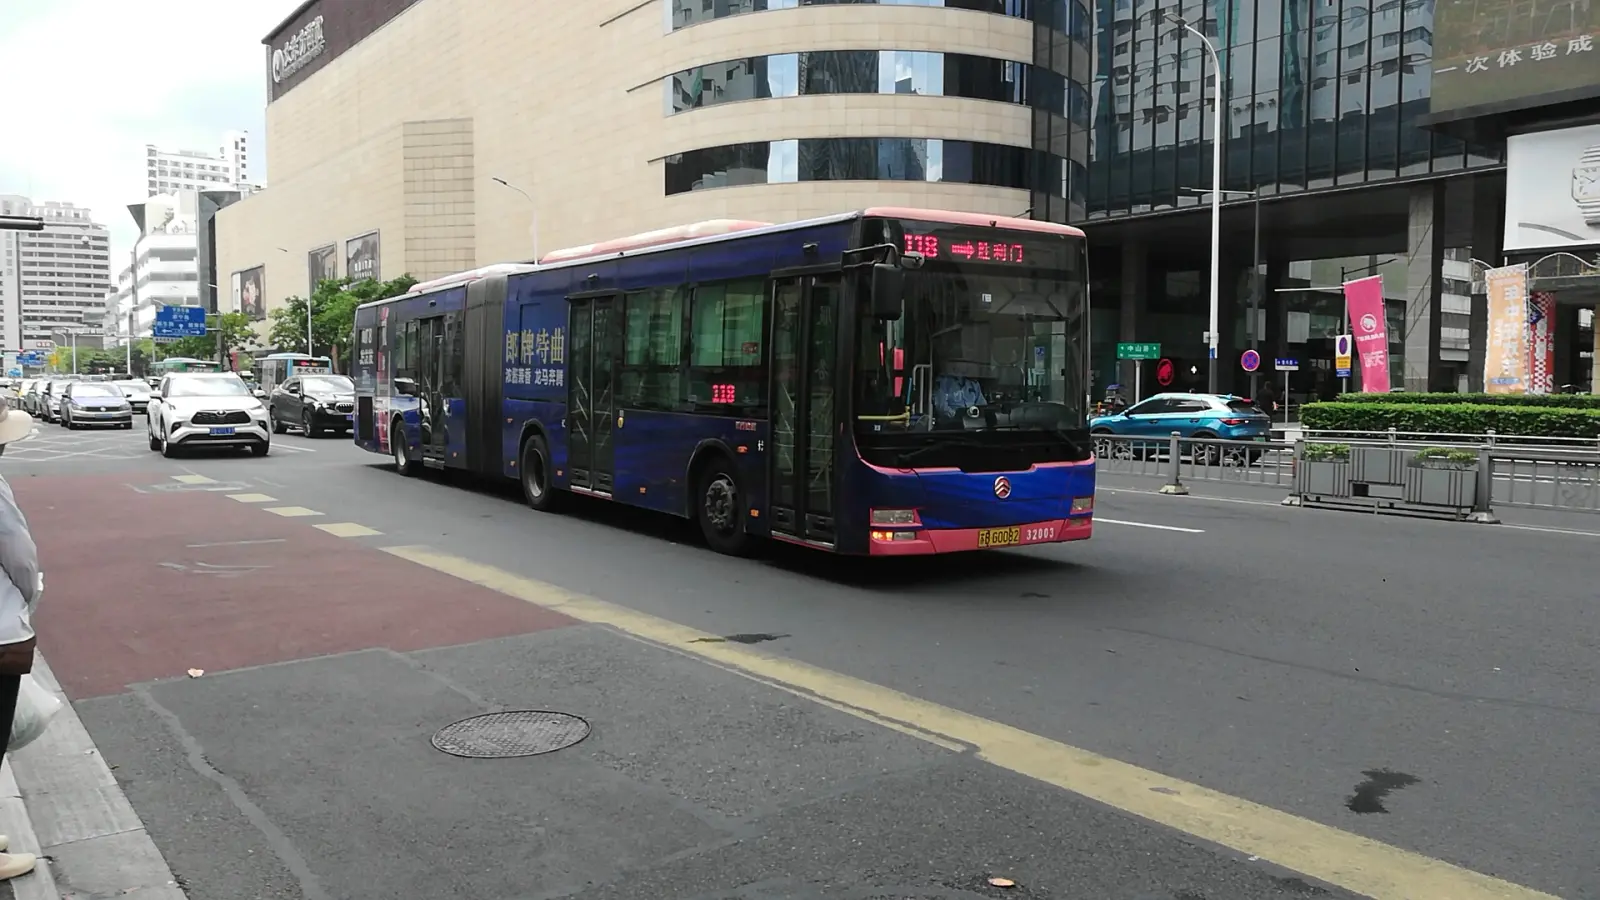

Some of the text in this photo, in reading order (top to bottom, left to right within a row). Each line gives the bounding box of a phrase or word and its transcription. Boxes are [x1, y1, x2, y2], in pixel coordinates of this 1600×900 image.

[1434, 34, 1594, 75] 一次体验成
[904, 234, 938, 258] 118
[978, 241, 1024, 263] 胜利门
[505, 328, 565, 365] 郎牌特曲
[534, 368, 564, 387] 龙马奔腾
[712, 384, 736, 404] 118
[1026, 527, 1055, 541] 32003
